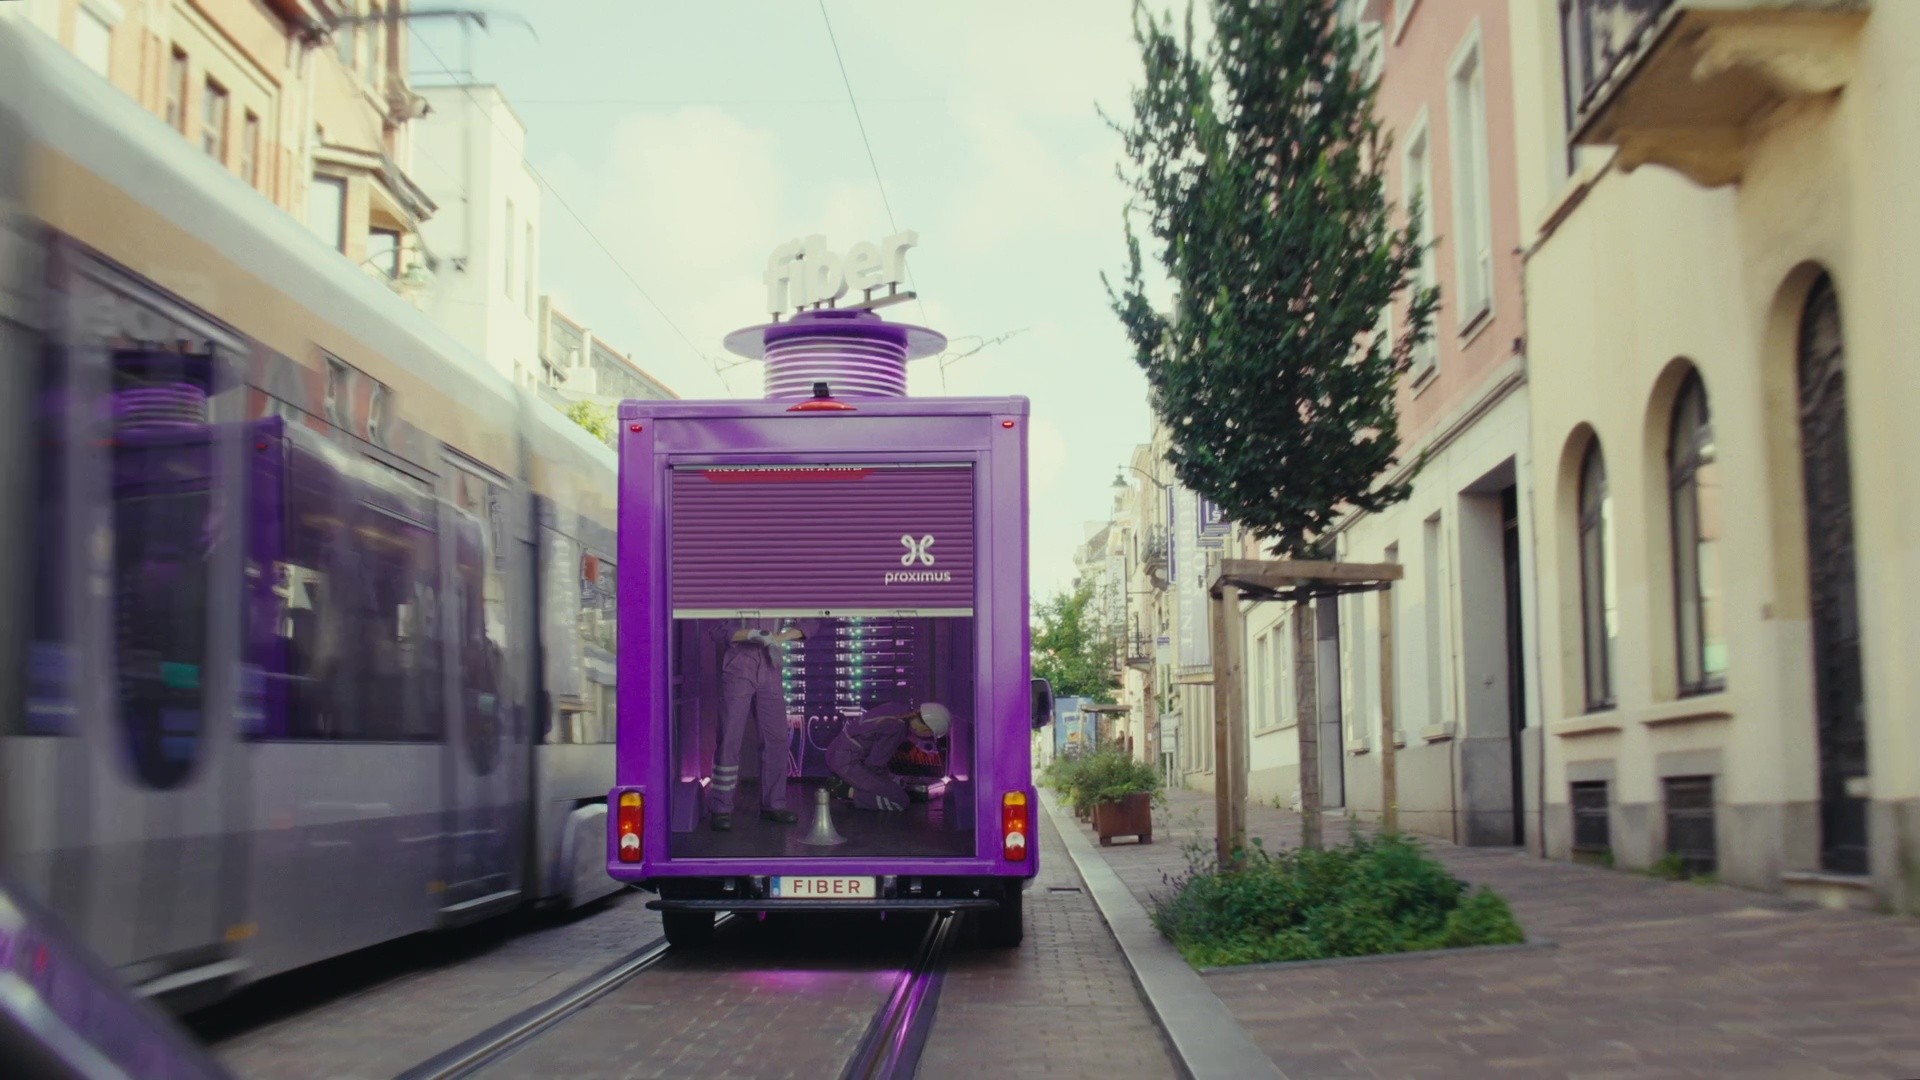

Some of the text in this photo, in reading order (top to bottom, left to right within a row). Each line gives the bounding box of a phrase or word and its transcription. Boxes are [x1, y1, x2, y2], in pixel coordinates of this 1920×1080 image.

[762, 229, 917, 314] fiber
[885, 571, 951, 586] proximus
[793, 879, 861, 894] FIBER
